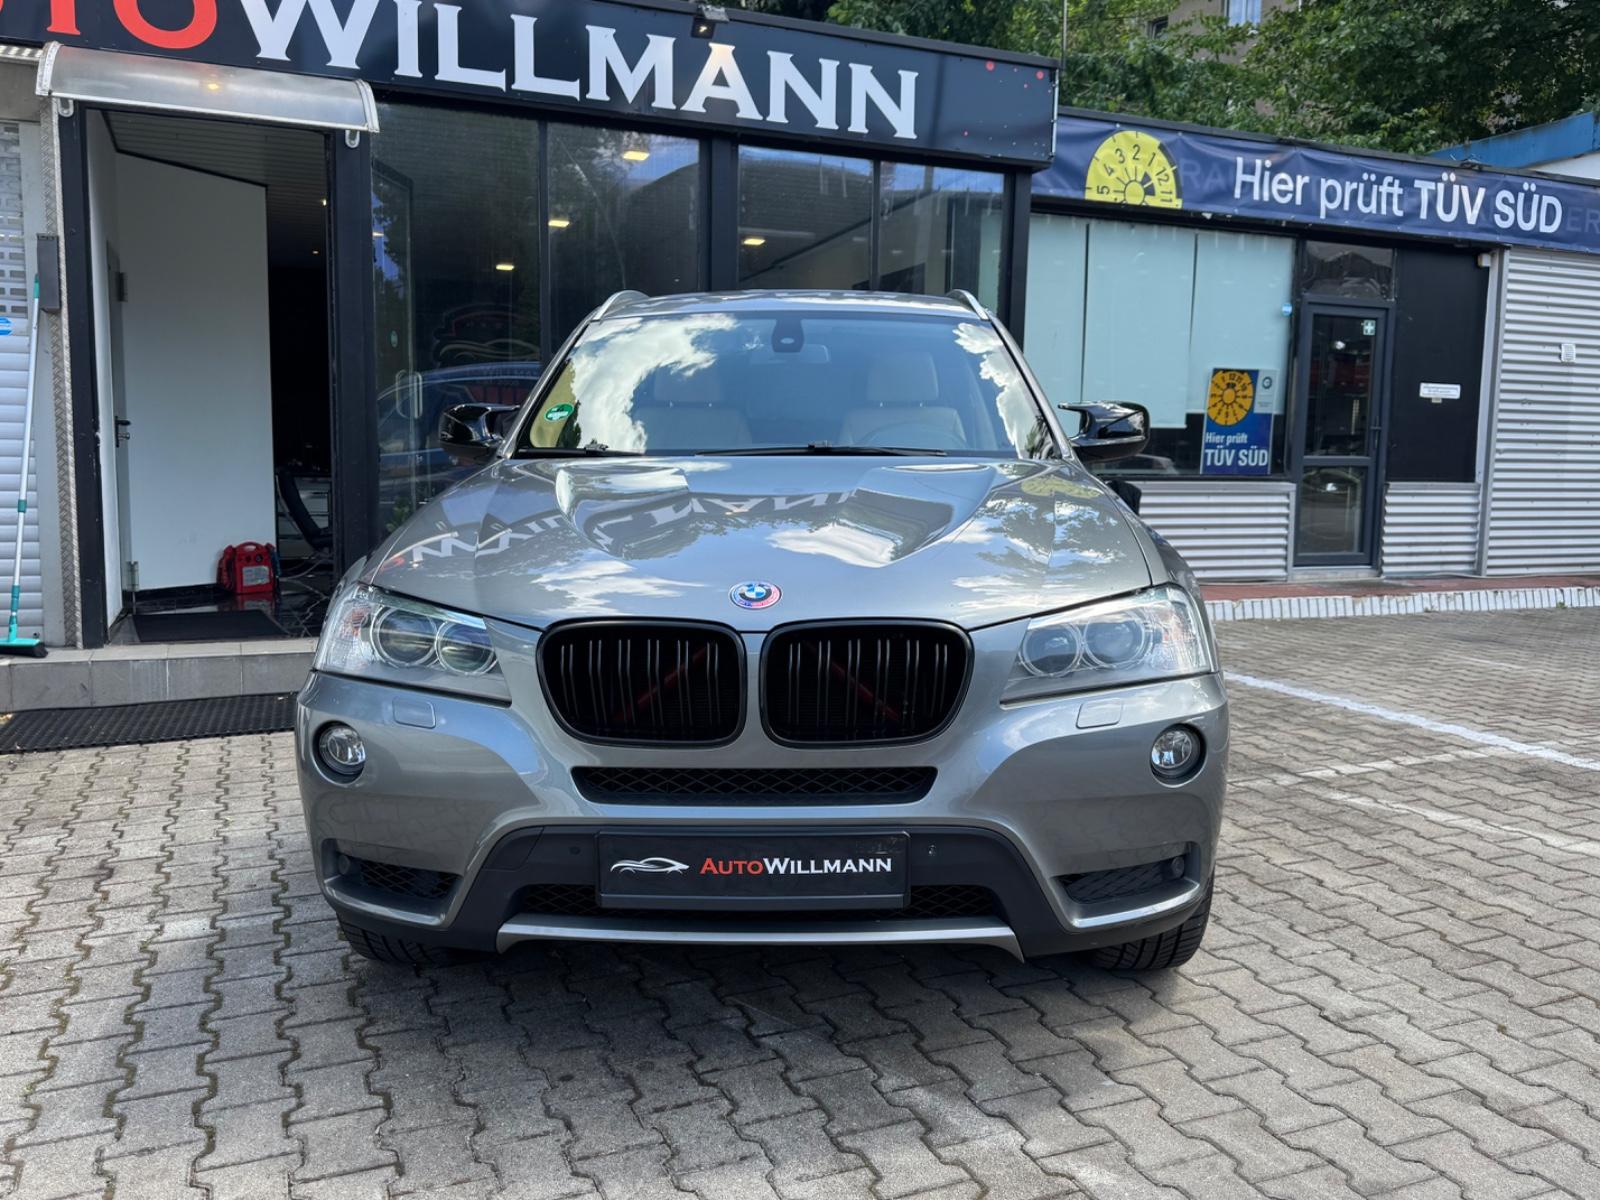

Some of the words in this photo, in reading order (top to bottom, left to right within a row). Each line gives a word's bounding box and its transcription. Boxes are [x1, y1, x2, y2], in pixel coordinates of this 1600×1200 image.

[1104, 164, 1115, 177] 4
[1115, 148, 1126, 164] 3
[1132, 144, 1141, 161] 2
[1155, 167, 1170, 186] 12
[1234, 156, 1310, 206] Hier
[1319, 172, 1404, 220] prüft
[1414, 171, 1486, 225] TÜV
[1494, 181, 1563, 234] SÜD
[1205, 432, 1225, 444] Hier
[1226, 432, 1248, 446] prüft
[1205, 445, 1235, 466] TÜV
[1238, 445, 1268, 466] SÜD
